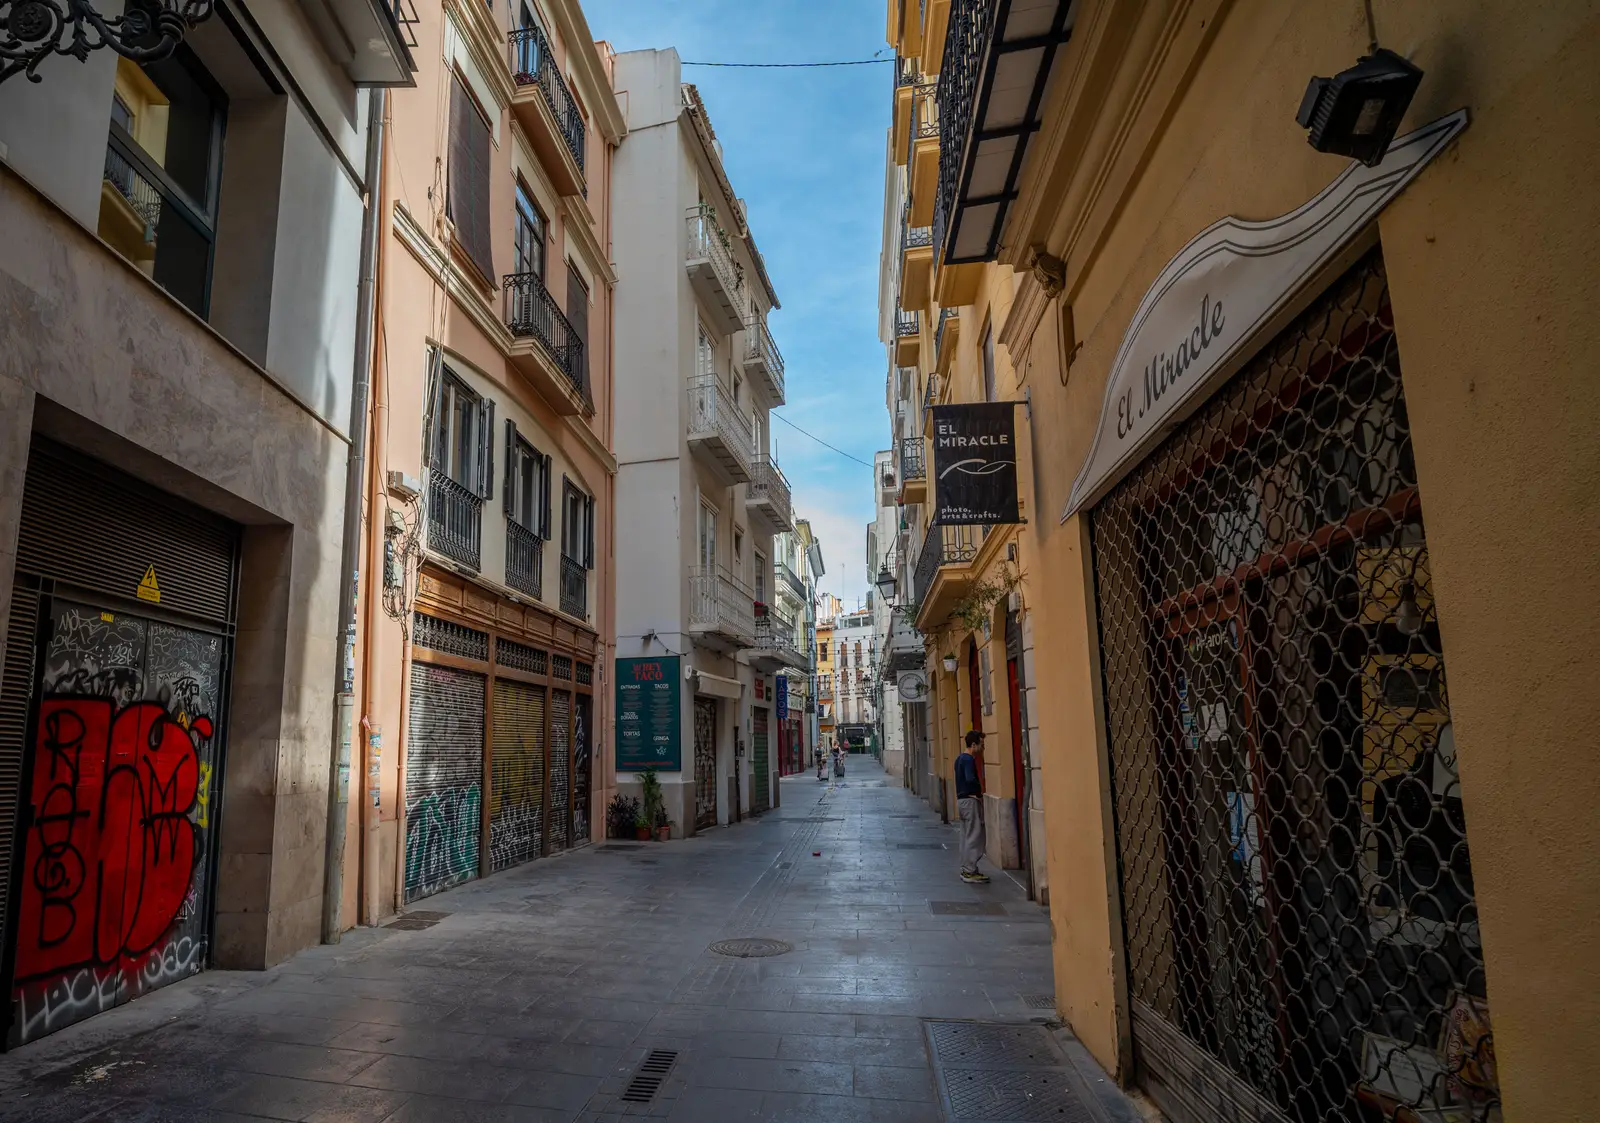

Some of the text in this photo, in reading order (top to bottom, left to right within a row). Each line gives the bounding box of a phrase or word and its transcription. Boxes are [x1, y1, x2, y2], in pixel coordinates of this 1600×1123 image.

[1117, 293, 1226, 440] El Miracle
[939, 424, 957, 435] EL
[940, 434, 1009, 447] MIRACLE
